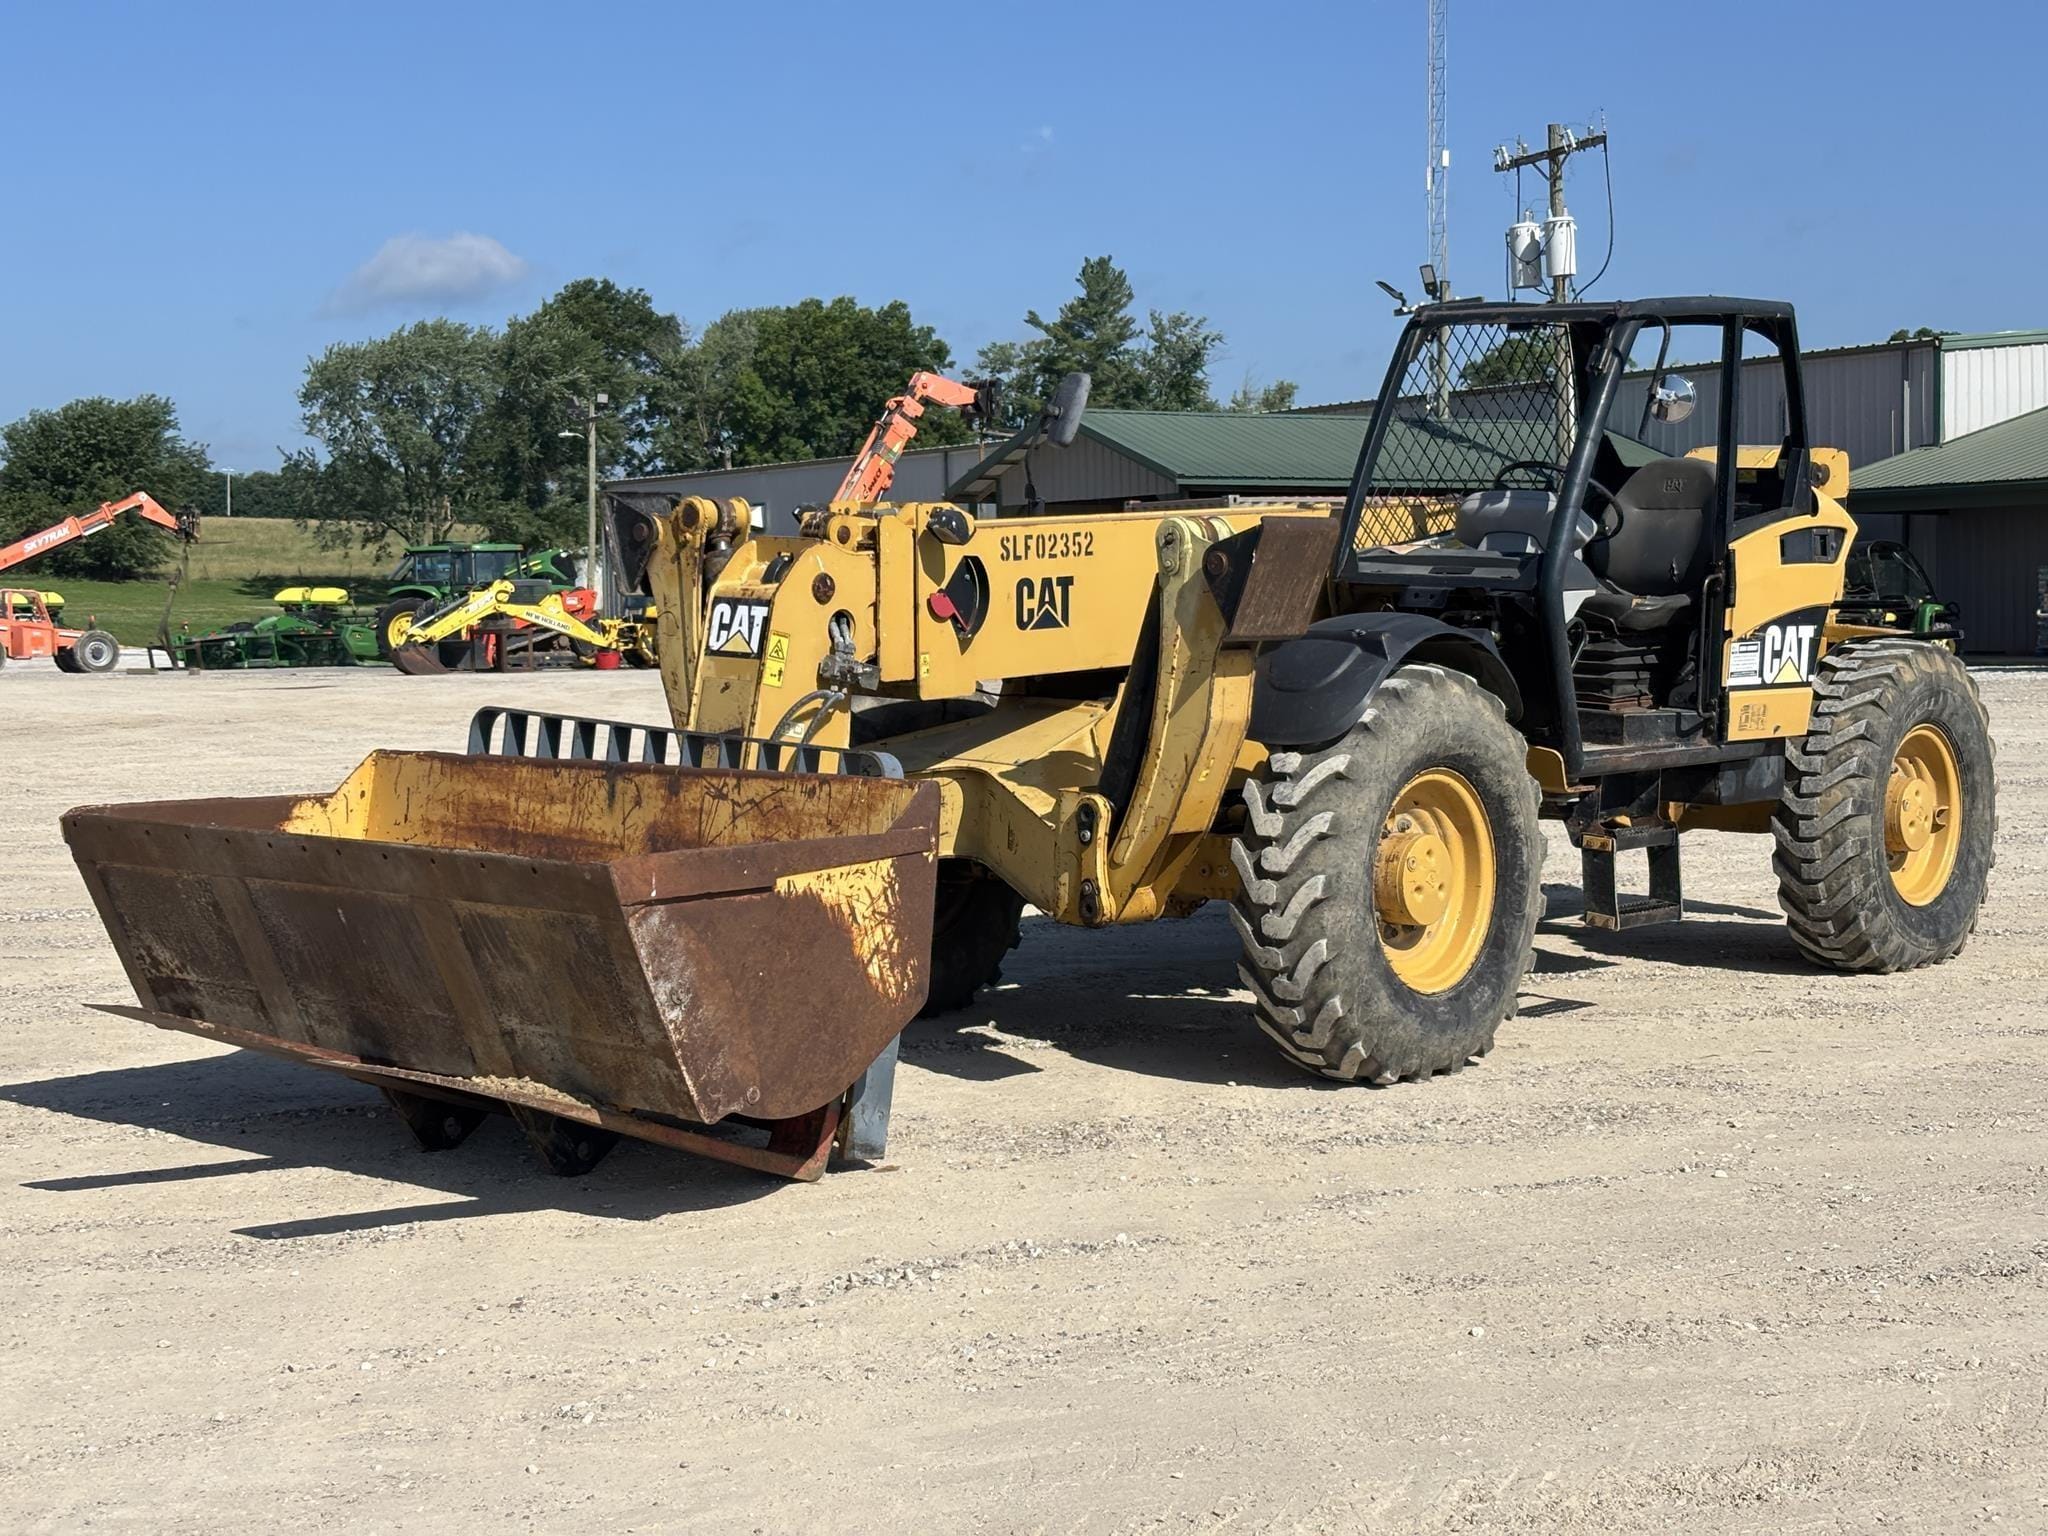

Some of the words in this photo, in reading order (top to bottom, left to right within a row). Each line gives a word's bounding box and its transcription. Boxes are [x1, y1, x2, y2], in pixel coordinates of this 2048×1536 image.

[23, 526, 70, 552] SKYTRAK
[1000, 531, 1094, 562] SLF02352
[525, 611, 540, 620] NEW
[541, 615, 570, 630] HOLLAND
[1016, 575, 1074, 631] CAT
[708, 603, 769, 654] CAT
[1763, 624, 1815, 685] CAT
